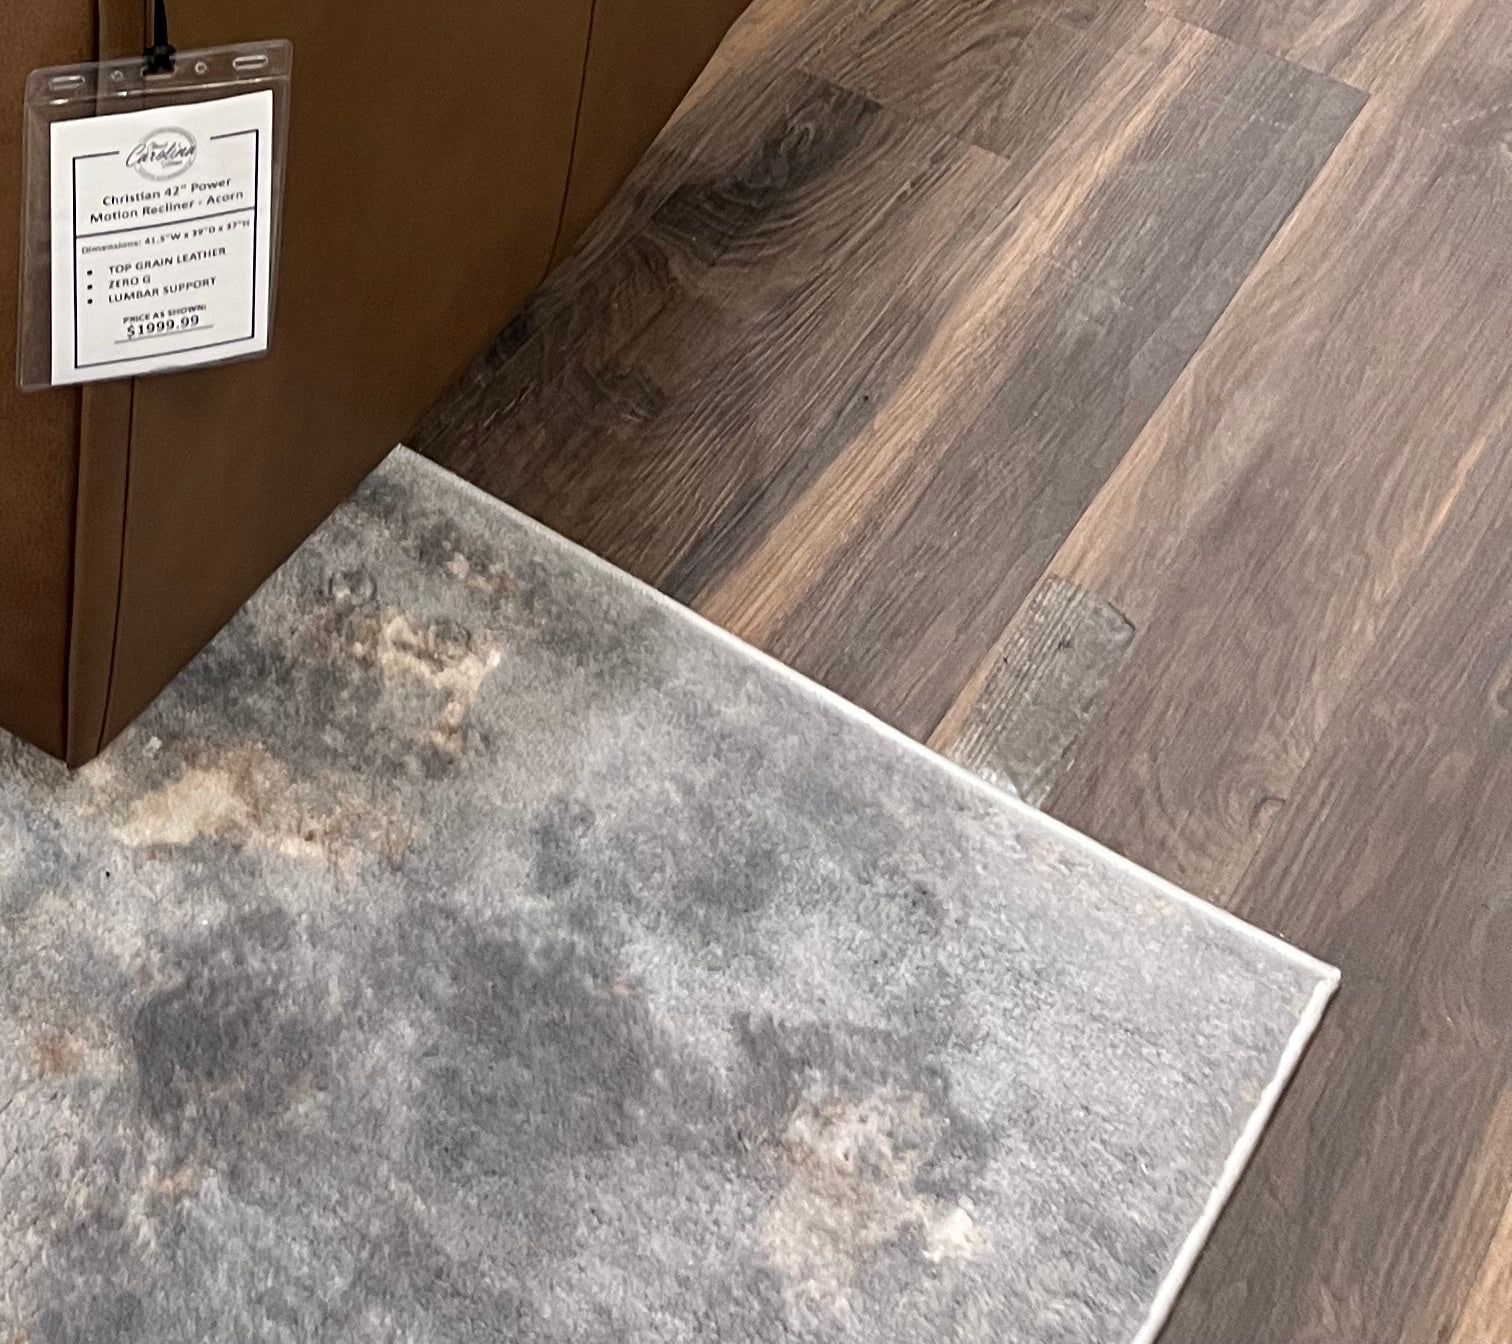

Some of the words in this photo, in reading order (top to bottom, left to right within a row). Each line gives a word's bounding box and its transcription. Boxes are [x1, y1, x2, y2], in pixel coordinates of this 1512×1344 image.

[102, 191, 161, 207] Christian
[164, 184, 187, 197] 42"
[191, 178, 232, 193] Power
[90, 210, 139, 225] Motion
[142, 200, 195, 216] Recliner
[206, 191, 244, 206] Acorn
[108, 263, 132, 276] TOP
[135, 257, 174, 271] GRAIN
[177, 247, 227, 263] LEATHER
[108, 277, 140, 290] ZERO
[142, 274, 152, 285] G
[108, 288, 160, 304] LUMBAR
[162, 278, 217, 294] SUPPORT
[123, 313, 151, 325] PRICE
[152, 312, 166, 321] AS
[127, 315, 200, 339] $1999.99
